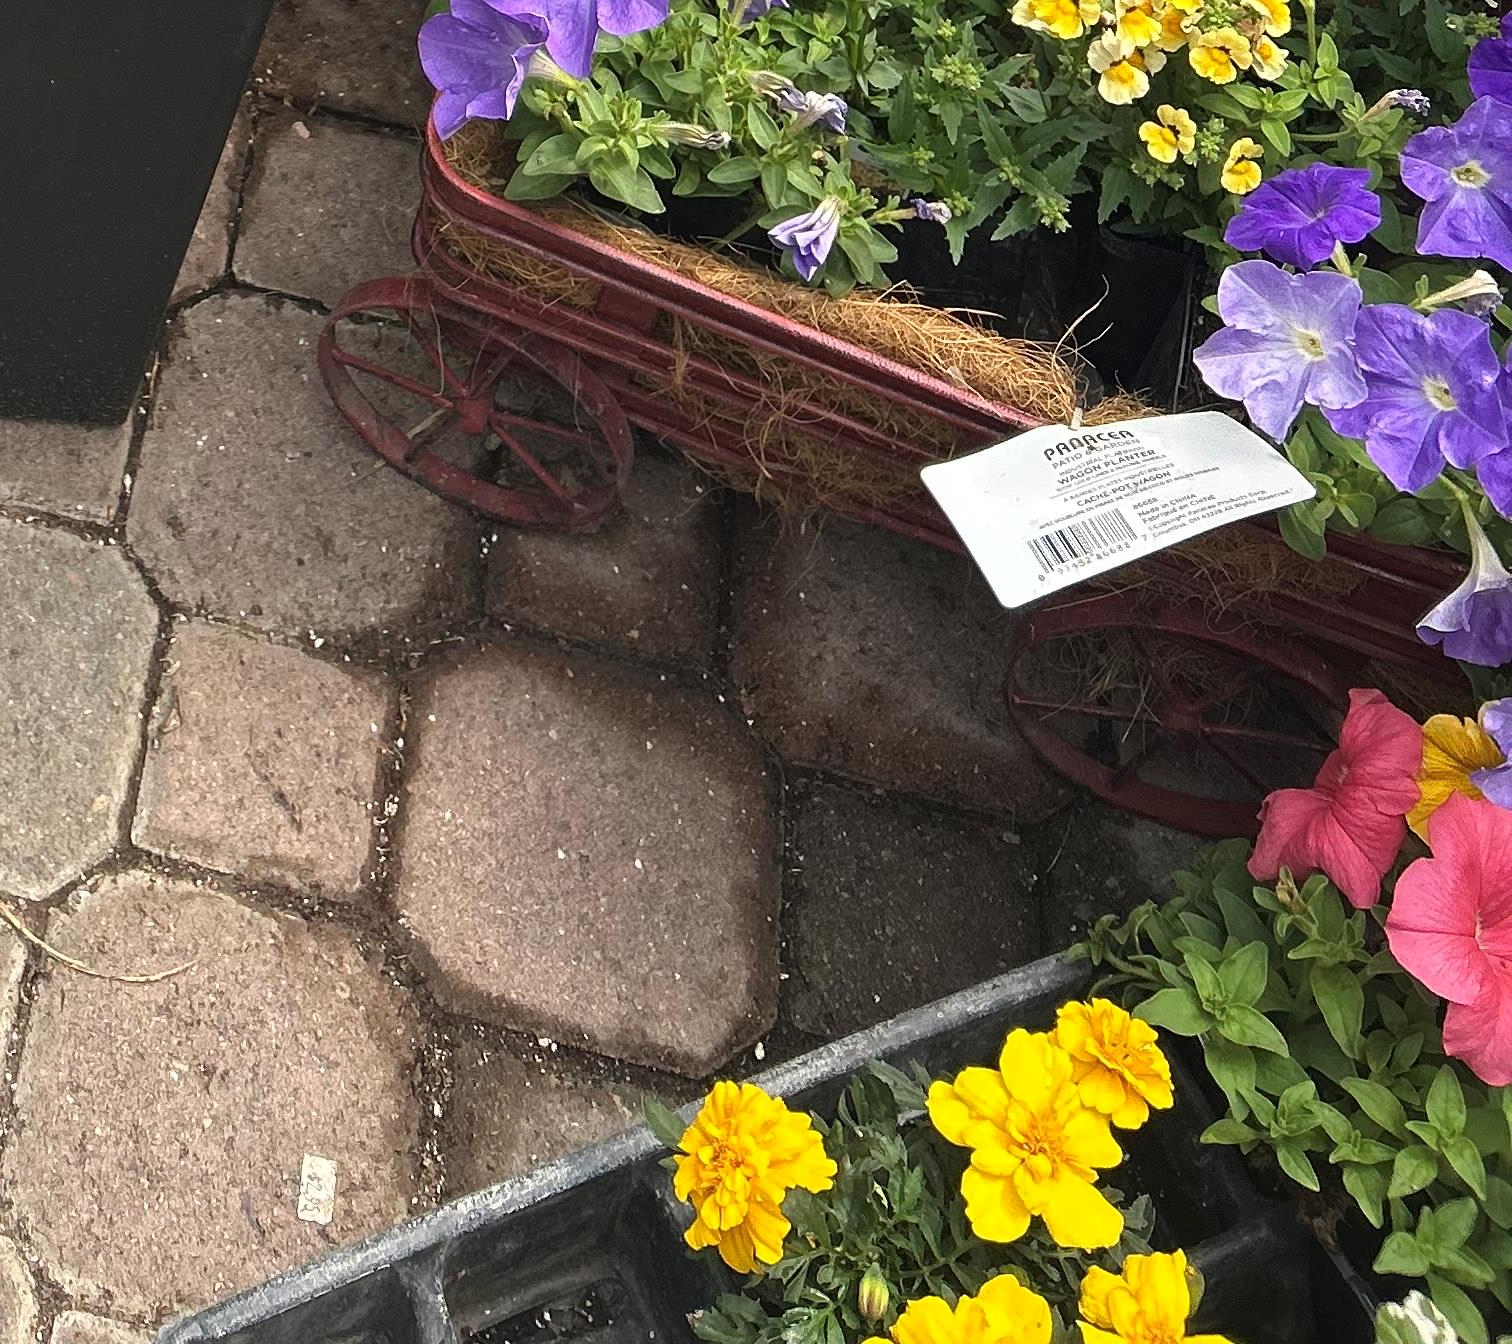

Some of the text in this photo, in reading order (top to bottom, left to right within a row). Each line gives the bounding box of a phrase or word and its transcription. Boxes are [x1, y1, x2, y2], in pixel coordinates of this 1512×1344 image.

[1051, 452, 1083, 470] PATIO
[1057, 463, 1102, 485] WAGON
[1103, 449, 1157, 468] PLANTER
[1169, 493, 1197, 506] CHINA
